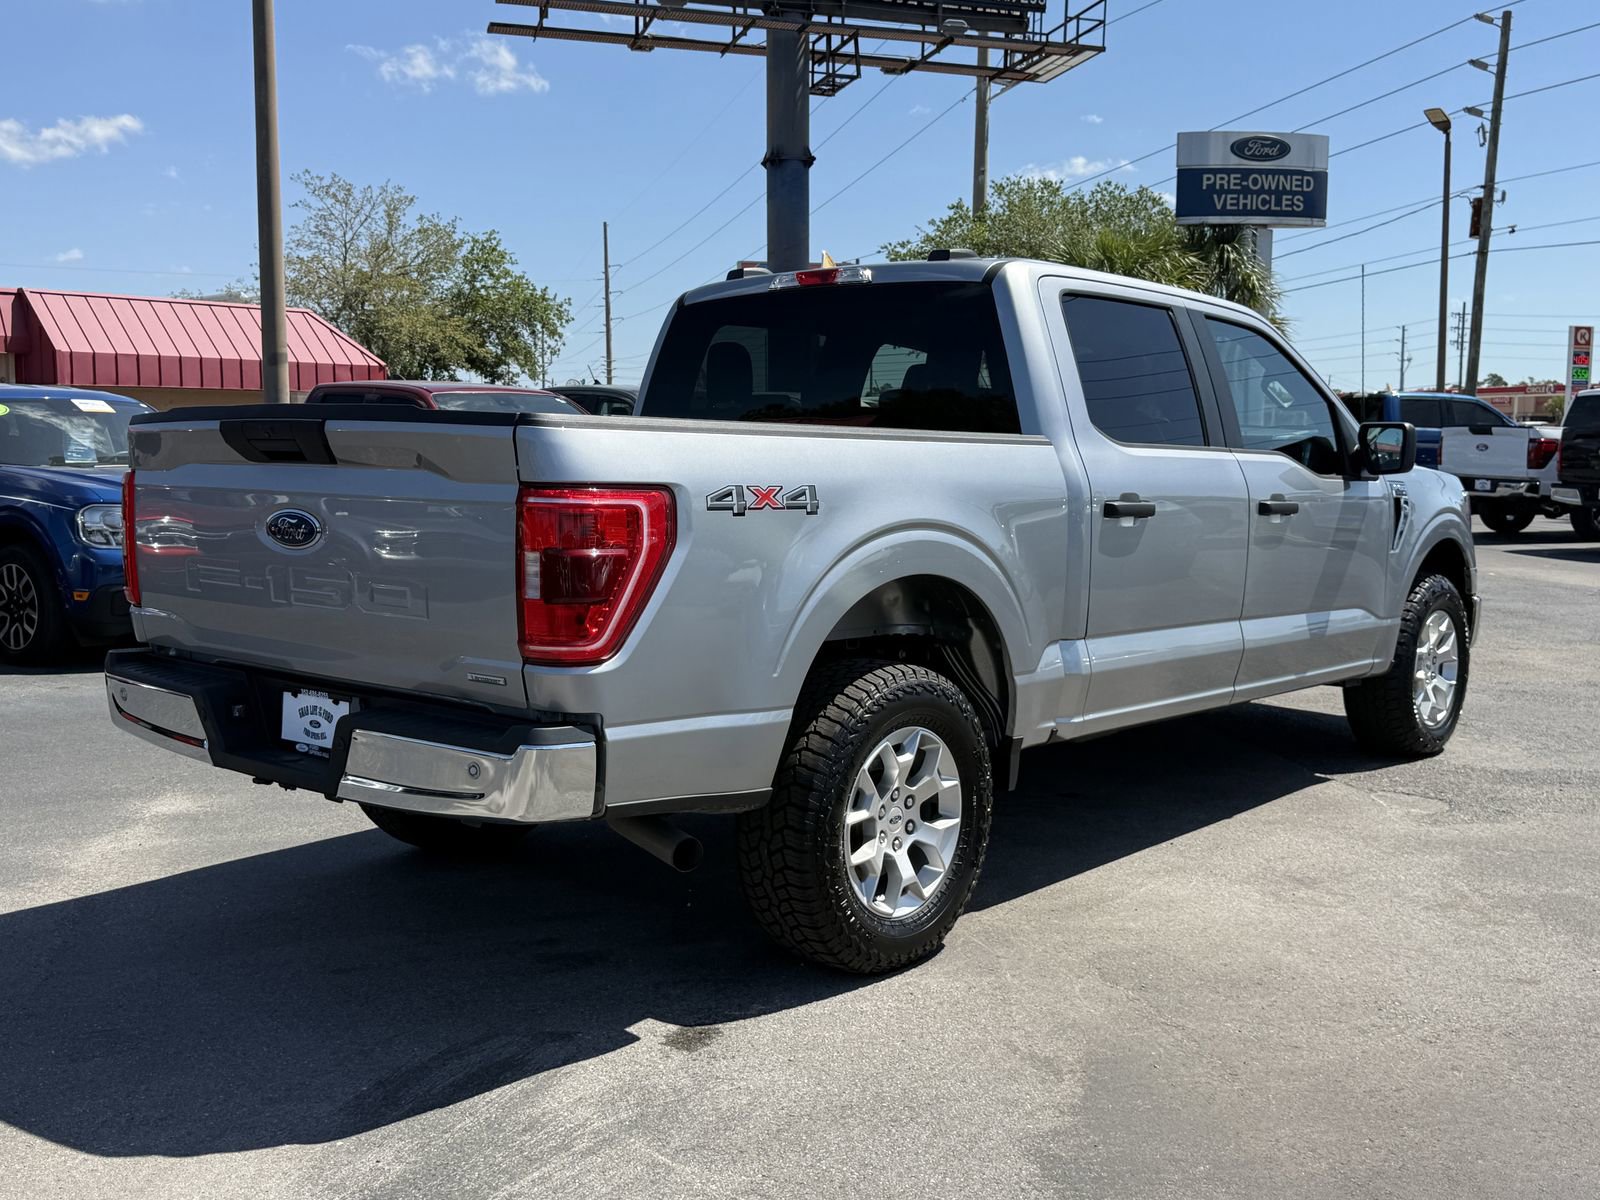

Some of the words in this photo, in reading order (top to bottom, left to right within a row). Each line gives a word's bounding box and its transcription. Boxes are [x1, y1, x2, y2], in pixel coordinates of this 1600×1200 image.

[1244, 139, 1280, 157] Ford
[1202, 173, 1314, 192] PRE-OWNED
[1213, 194, 1304, 212] VEHICLES
[705, 484, 820, 518] 4X4
[275, 516, 307, 541] Ford
[186, 558, 430, 621] F-150
